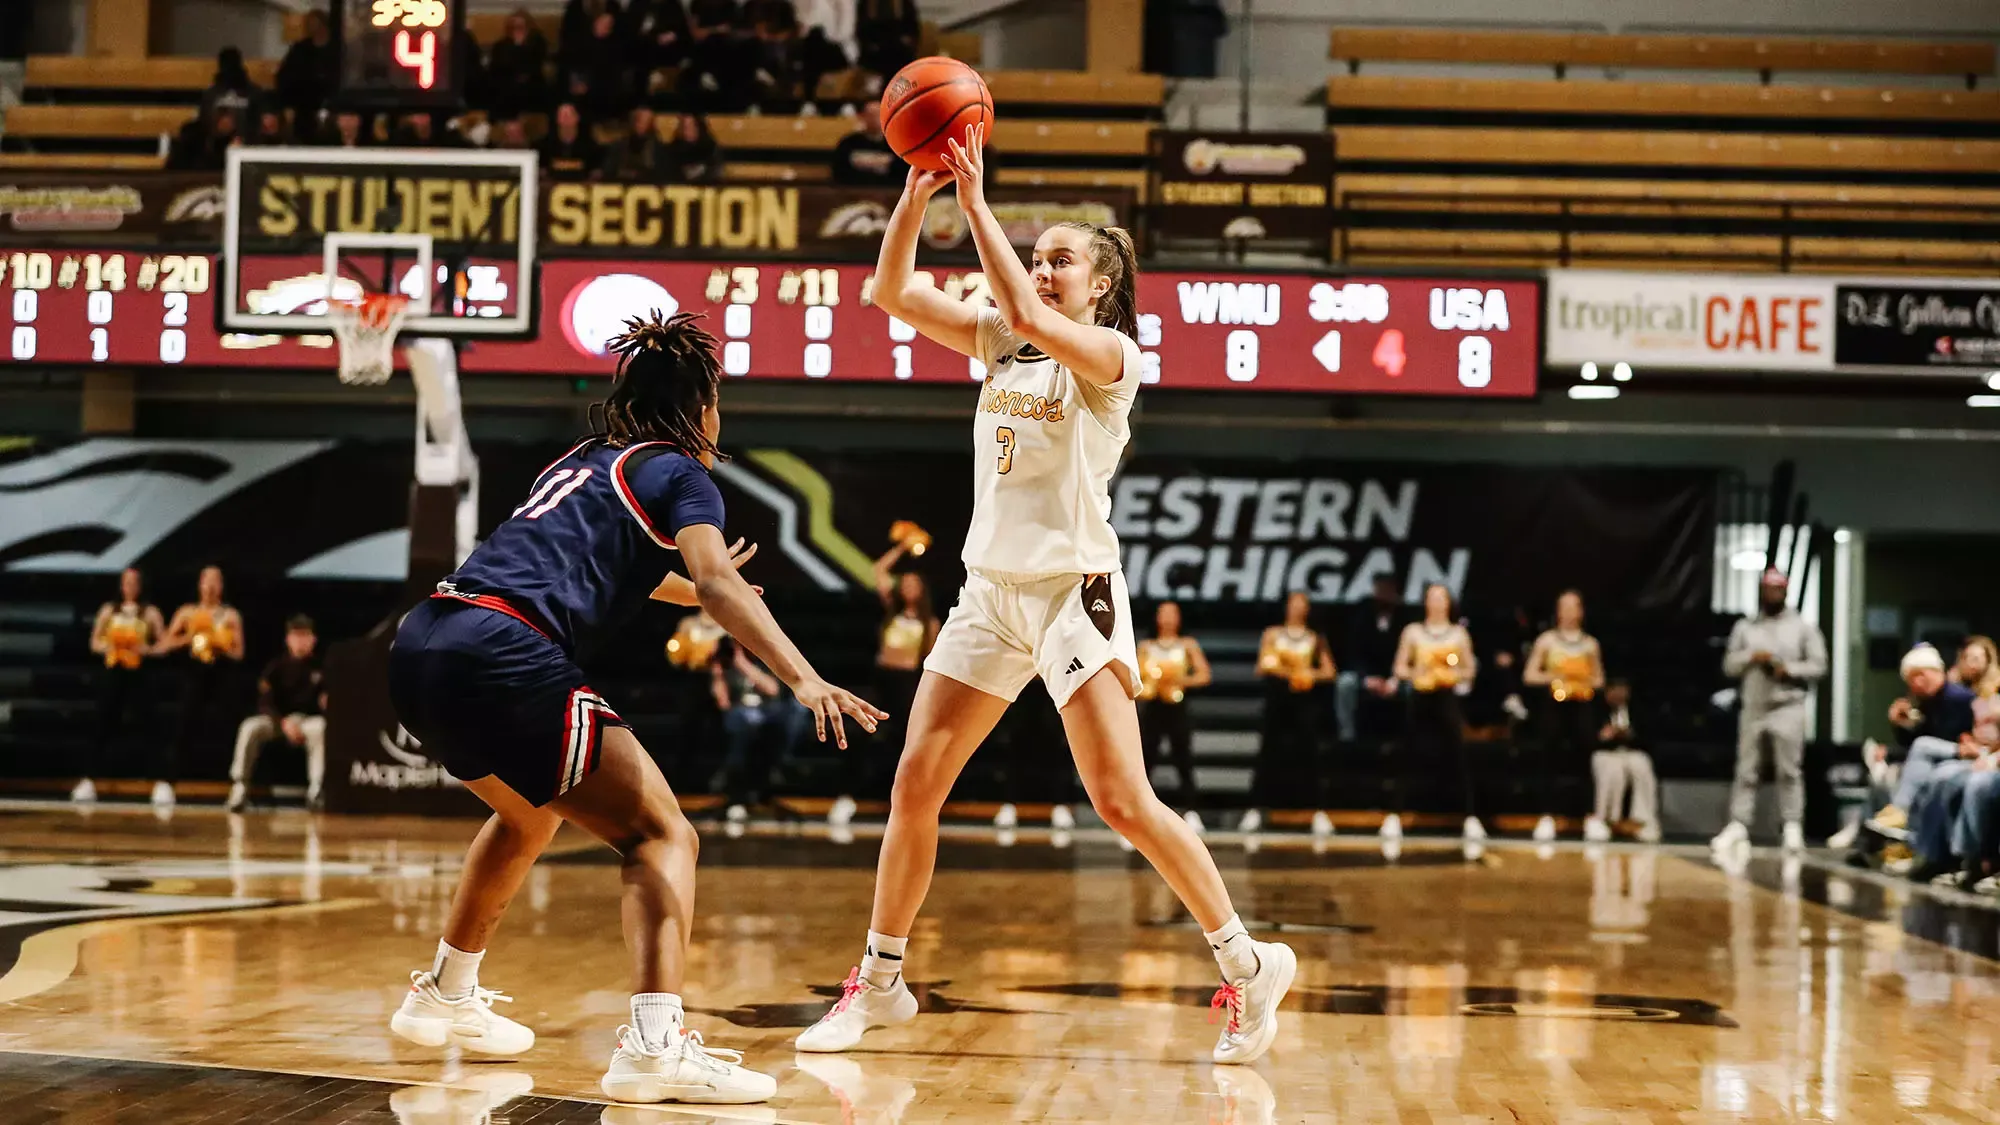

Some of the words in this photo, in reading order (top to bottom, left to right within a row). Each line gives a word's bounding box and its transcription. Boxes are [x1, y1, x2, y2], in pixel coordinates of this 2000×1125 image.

[395, 30, 435, 89] 4
[258, 173, 520, 241] STUDENT
[550, 183, 798, 250] SECTION
[57, 253, 127, 292] #14
[137, 255, 209, 293] #20
[705, 267, 759, 304] #3
[777, 268, 840, 306] #11
[13, 289, 38, 323] 0
[87, 290, 113, 325] 0
[162, 292, 188, 327] 2
[1177, 281, 1281, 326] WMU
[1429, 287, 1509, 331] USA
[1559, 293, 1697, 337] tropical
[1705, 296, 1822, 354] CAFE
[12, 325, 37, 361] 0
[89, 327, 109, 363] 1
[159, 329, 187, 364] 0
[892, 345, 913, 380] 1
[1226, 329, 1259, 382] 8
[1372, 328, 1406, 377] 4
[1458, 335, 1492, 388] 8
[996, 425, 1015, 475] 3
[512, 468, 593, 520] 11
[1113, 476, 1418, 541] ESTERN
[1122, 546, 1471, 605] ICHIGAN
